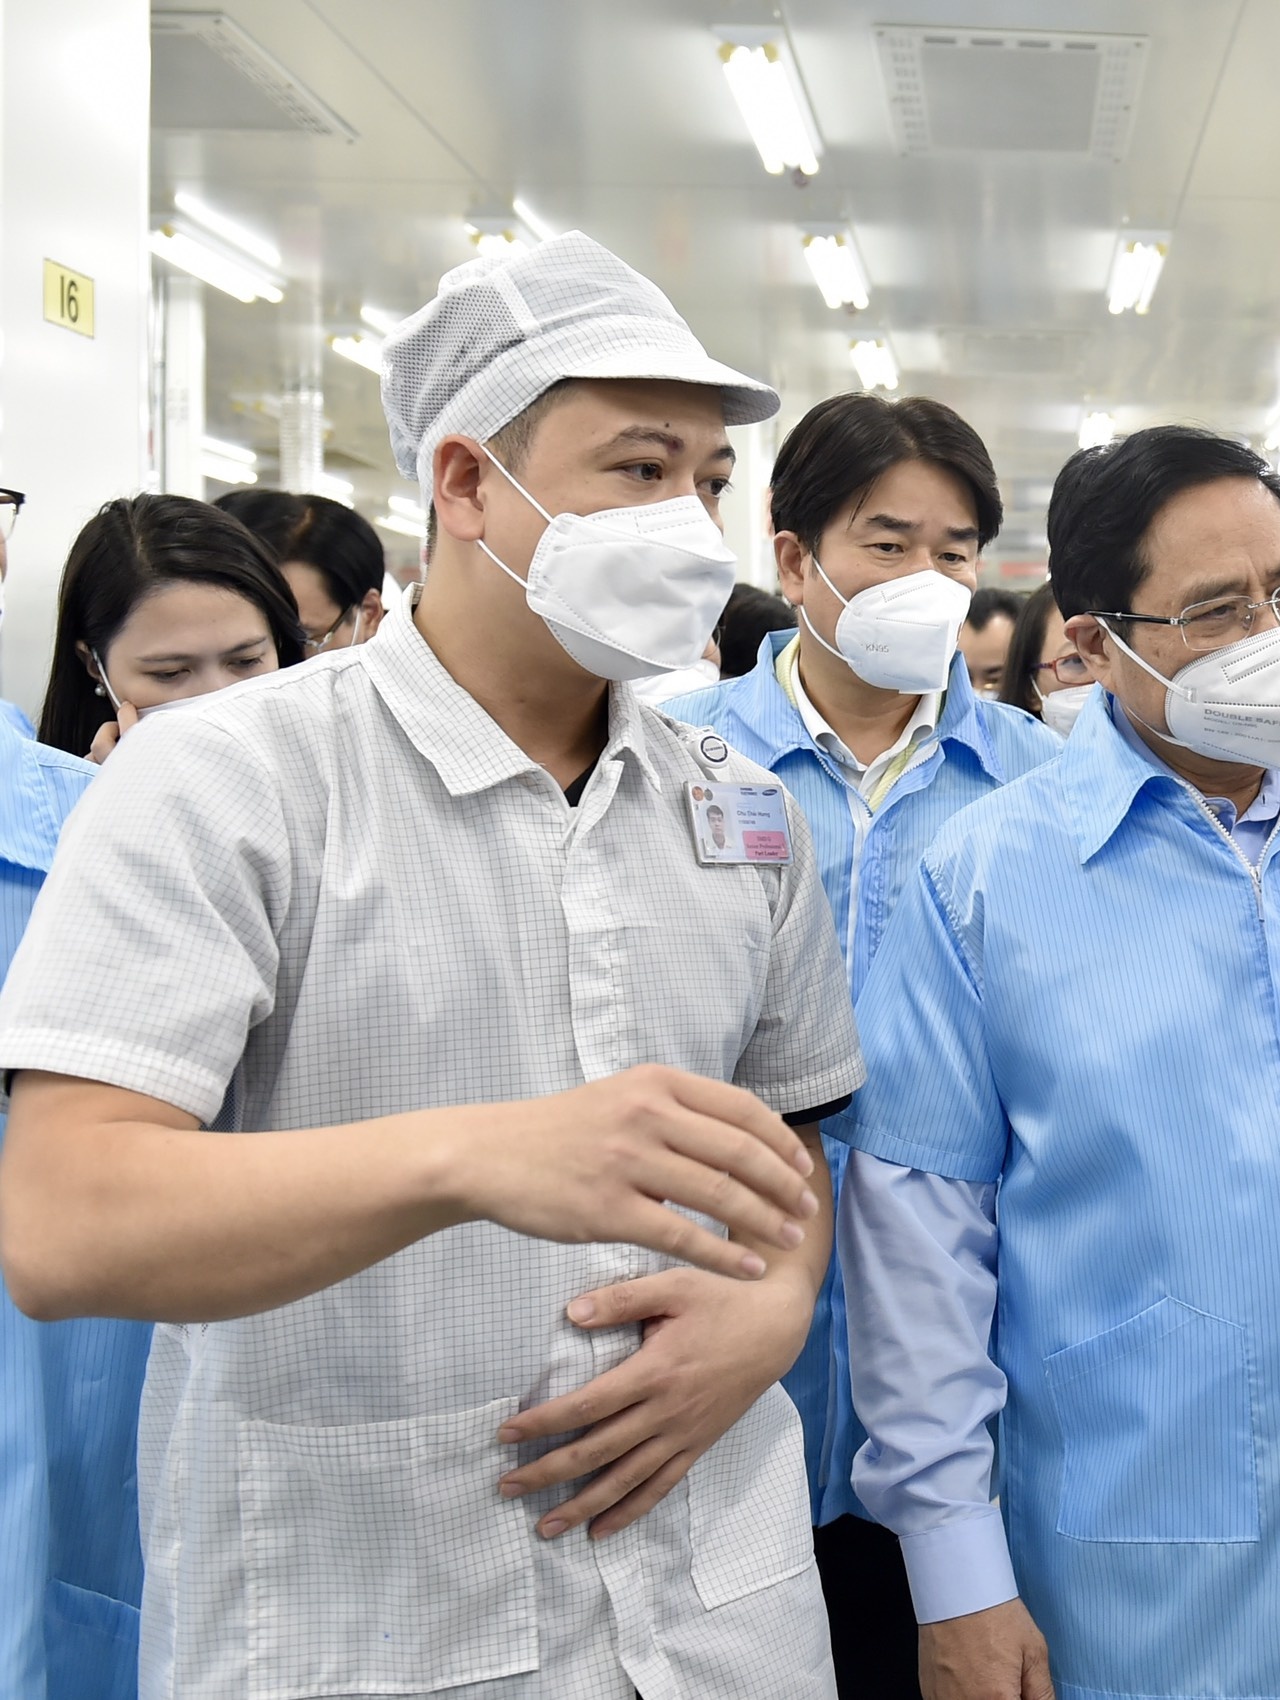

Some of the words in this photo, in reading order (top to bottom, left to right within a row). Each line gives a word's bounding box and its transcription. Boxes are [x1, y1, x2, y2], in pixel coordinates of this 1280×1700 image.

[60, 275, 79, 323] 16
[865, 644, 889, 653] KN95
[1204, 708, 1252, 722] DOUBLE
